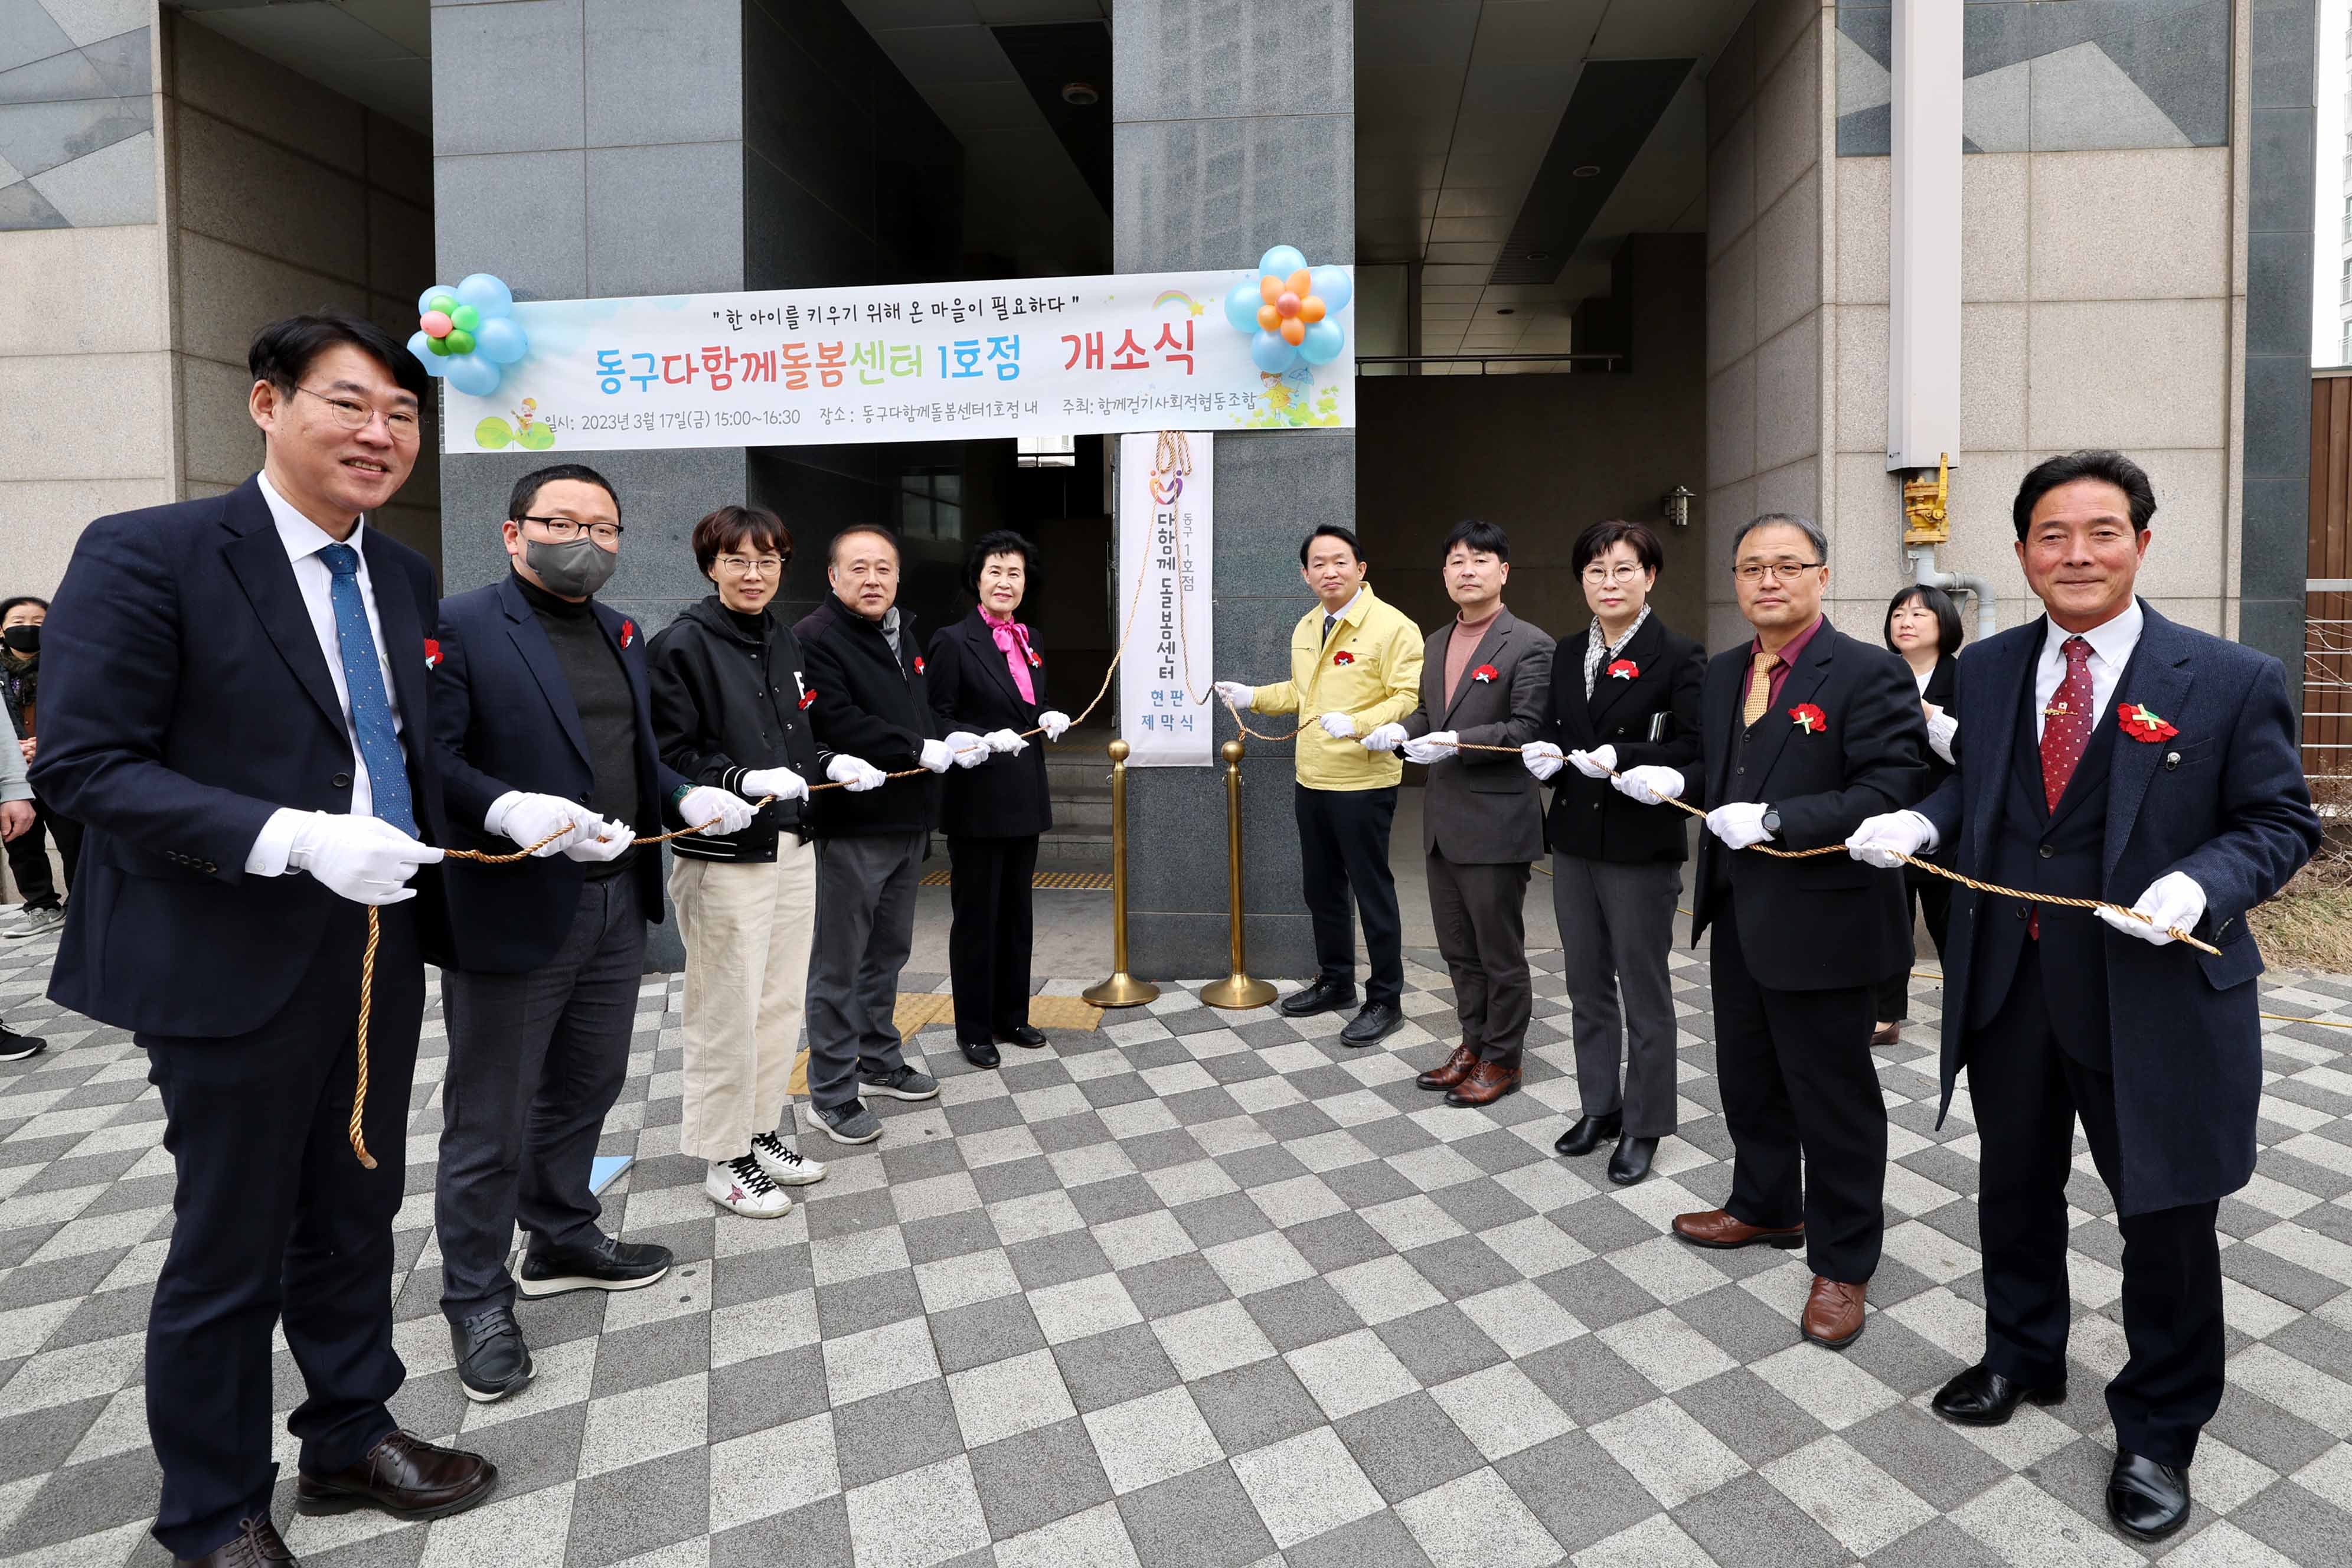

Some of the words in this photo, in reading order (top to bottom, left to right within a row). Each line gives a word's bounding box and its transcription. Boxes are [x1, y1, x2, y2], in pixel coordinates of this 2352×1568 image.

[750, 305, 799, 330] 아이를
[807, 303, 857, 326] 키우기
[866, 301, 901, 324] 위해
[909, 300, 923, 324] 온
[931, 298, 982, 324] 마을이
[596, 339, 922, 394] 동구다함께돌봄센터
[937, 334, 1020, 381] 1호점
[1061, 319, 1194, 375] 개소식
[545, 416, 574, 433] 일시:
[582, 413, 629, 431] 2023년
[633, 412, 655, 431] 3월
[661, 410, 710, 430] 17일(금)
[715, 409, 801, 426] 15:00~16:30
[862, 400, 1019, 424] 동구다함께돌봄센터1호점
[1024, 400, 1038, 415] 내
[1062, 398, 1094, 416] 주최:
[1097, 391, 1258, 414] 함께걷기사회적협동조합
[1157, 512, 1175, 571] 다함께
[1182, 513, 1193, 538] 동구
[1181, 544, 1194, 592] 1호점
[1157, 578, 1175, 680] 돌봄센터
[1151, 690, 1184, 707] 현판
[1141, 714, 1194, 731] 제막식
